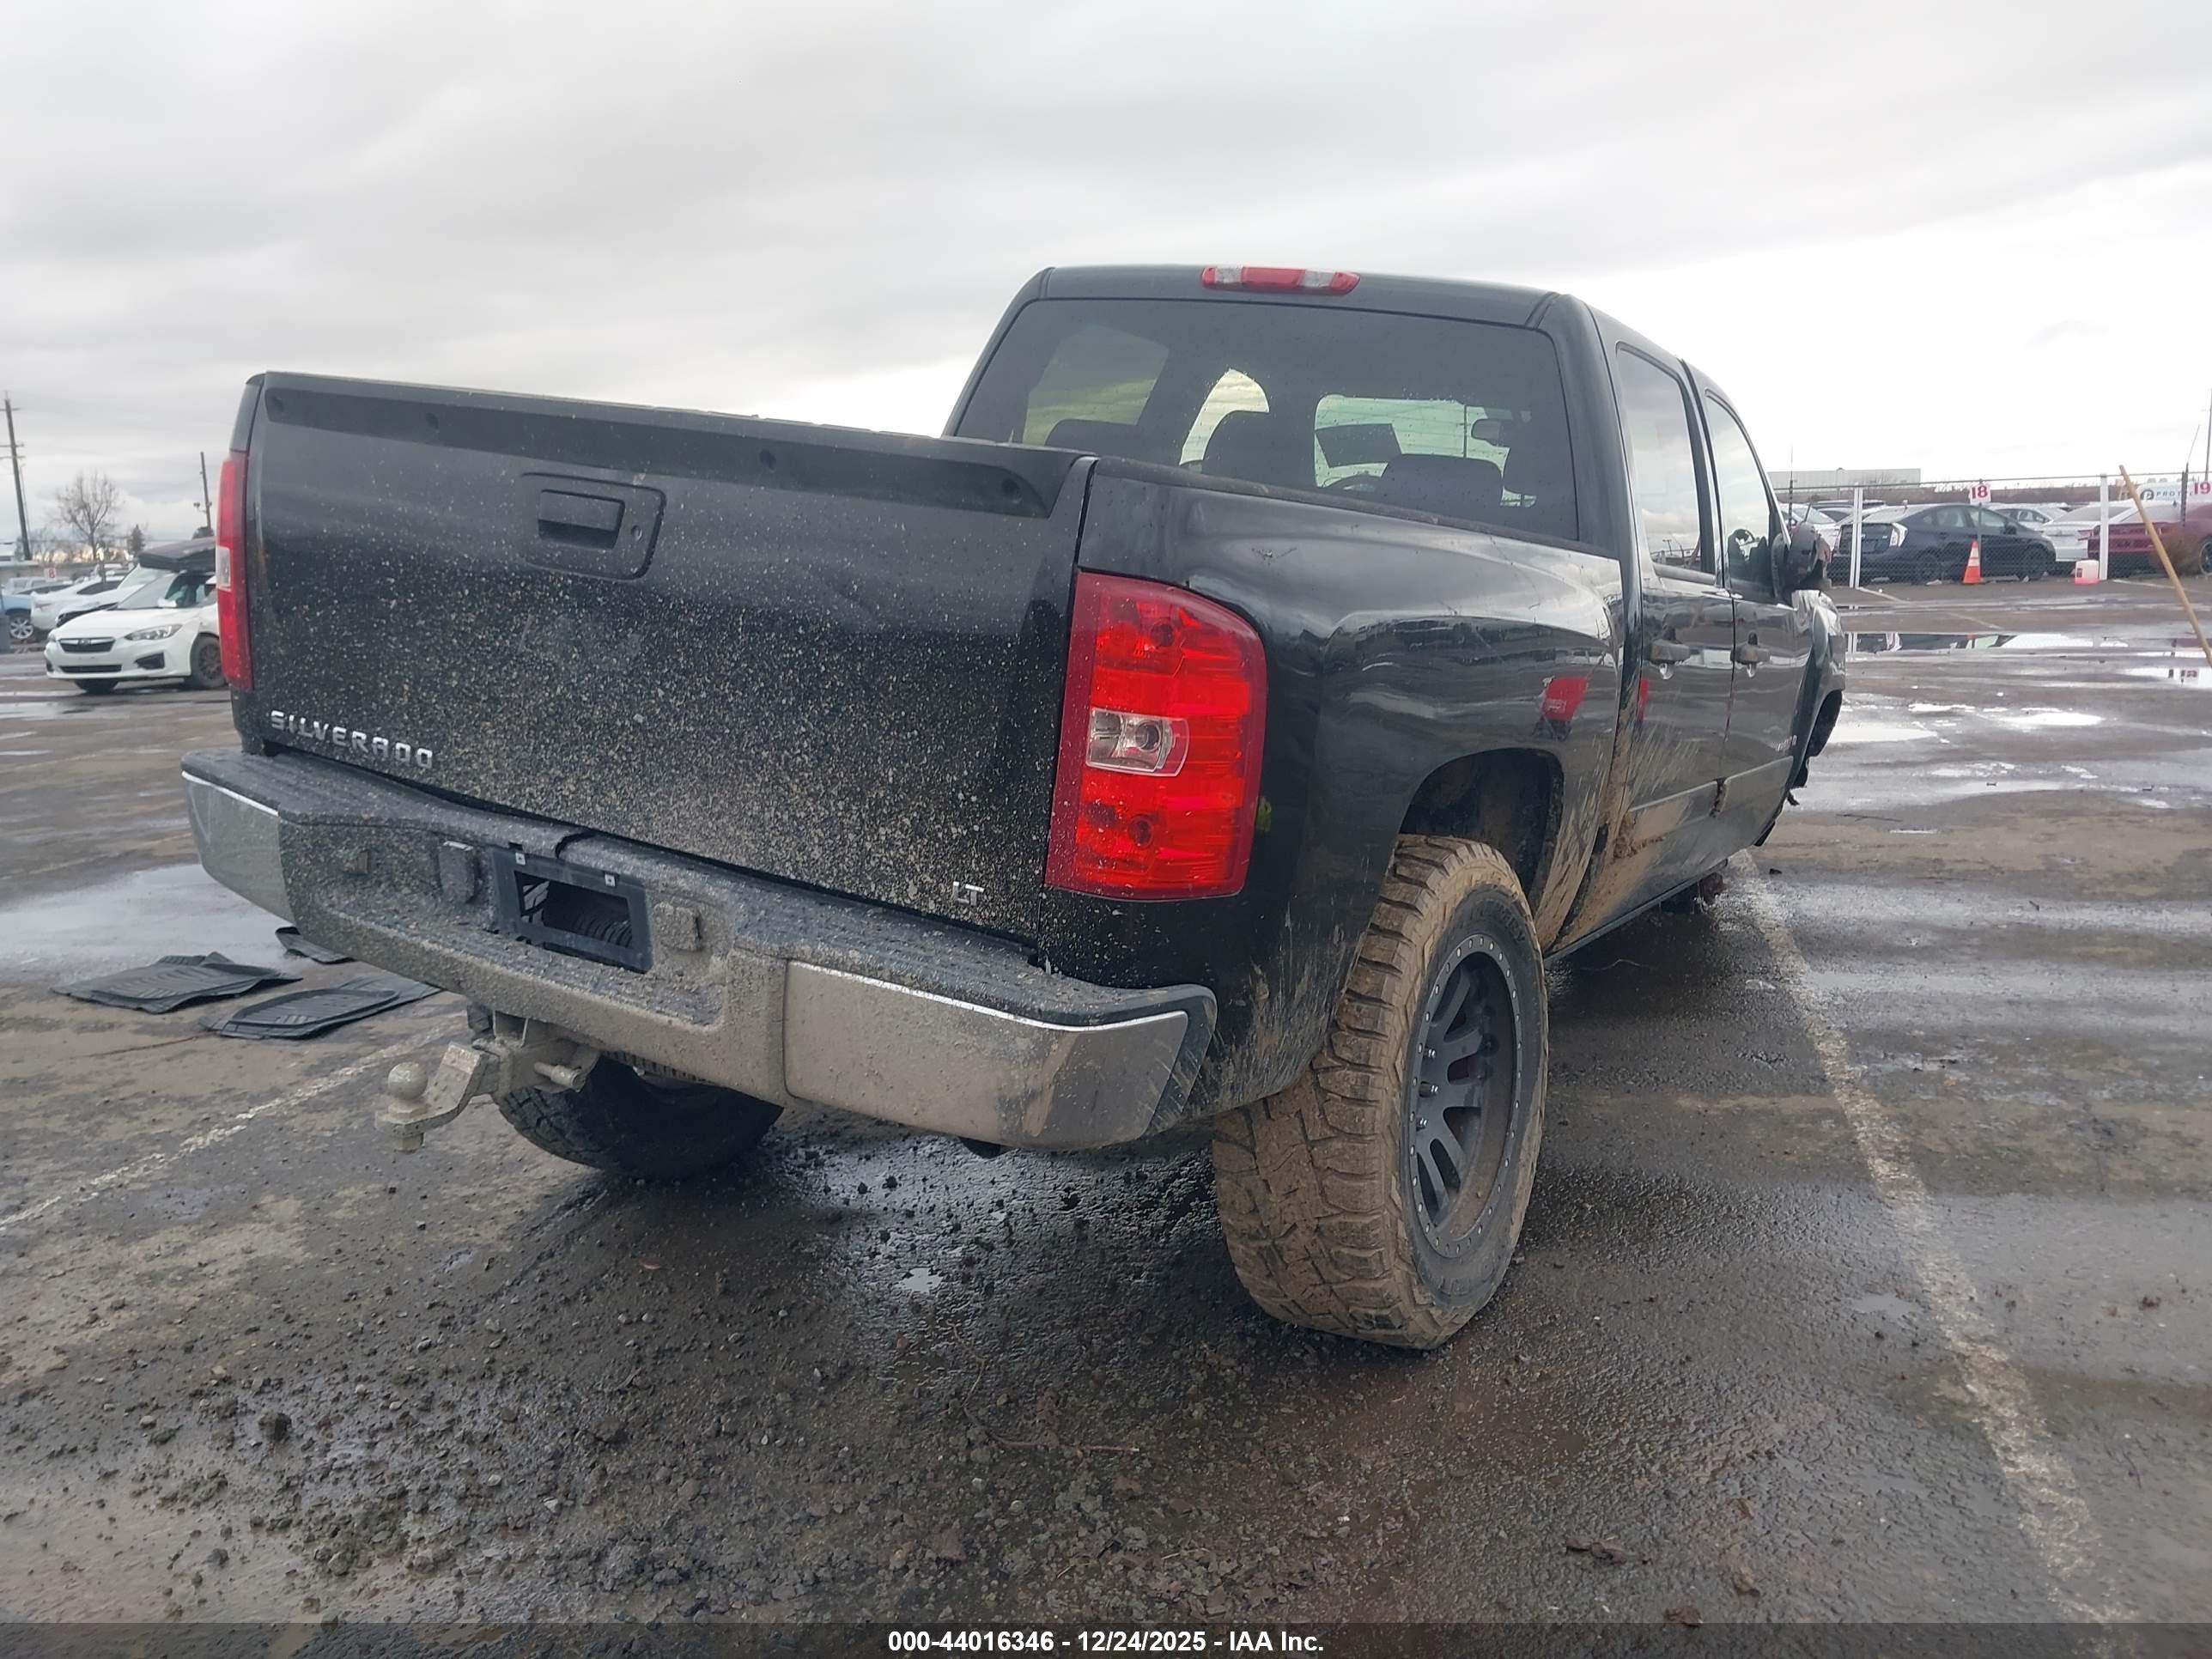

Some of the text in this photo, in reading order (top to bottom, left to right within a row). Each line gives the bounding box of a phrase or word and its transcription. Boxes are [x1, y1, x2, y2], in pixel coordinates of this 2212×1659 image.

[1972, 484, 1989, 499] 18
[2194, 481, 2211, 495] 19
[270, 710, 434, 769] SILVERADO
[951, 881, 985, 906] LT
